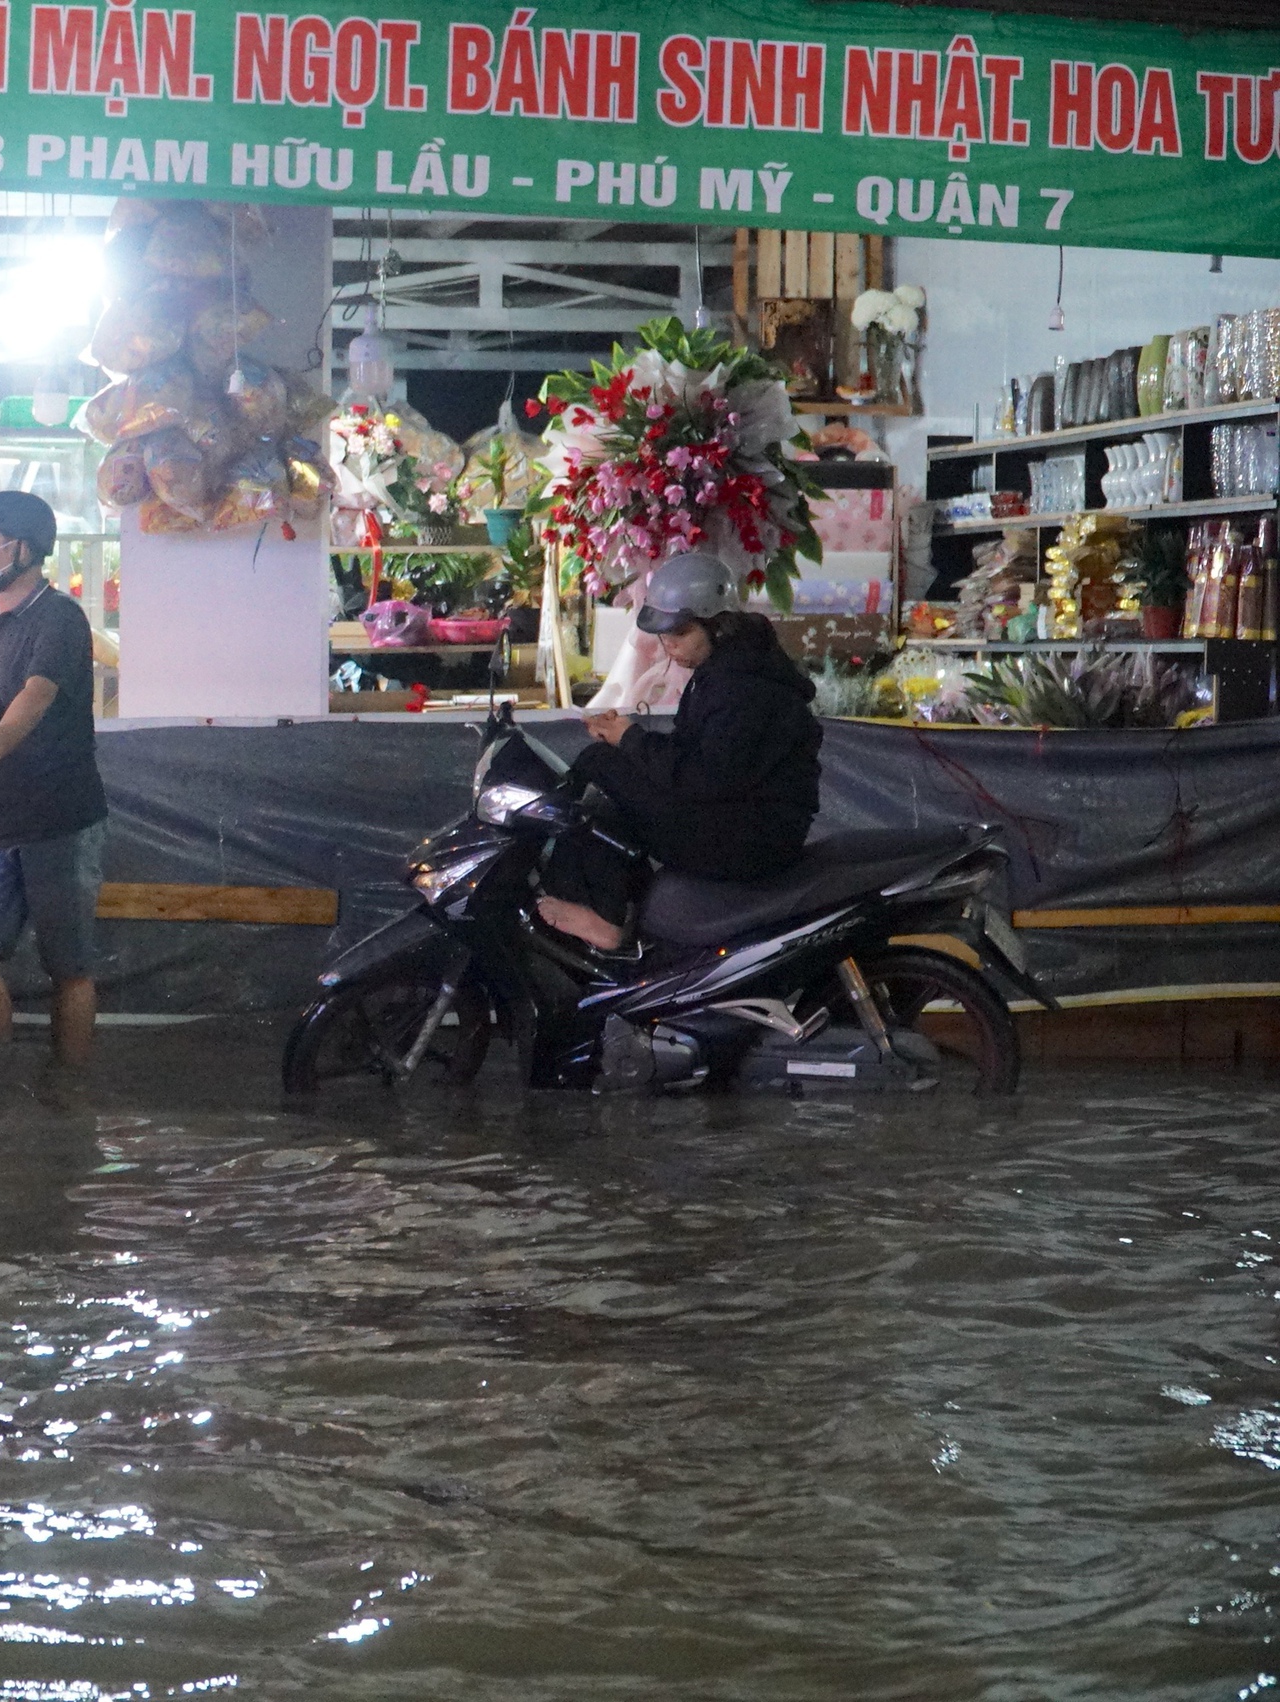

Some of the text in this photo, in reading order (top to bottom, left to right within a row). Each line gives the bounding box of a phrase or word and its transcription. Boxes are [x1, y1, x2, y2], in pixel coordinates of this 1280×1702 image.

[233, 12, 428, 129] NGỌT.
[447, 7, 640, 124] BÁNH
[656, 34, 827, 134] SINH
[842, 34, 1030, 163] NHẬT.
[1048, 60, 1183, 158] HOA
[1196, 66, 1280, 165] TƯ
[27, 133, 209, 191] PHẠM
[231, 137, 354, 191] HỮU
[376, 137, 490, 197] LẦU
[555, 156, 678, 208] PHÚ
[700, 162, 794, 215] MỸ
[856, 172, 1020, 234] QUẬN
[1039, 188, 1075, 231] 7
